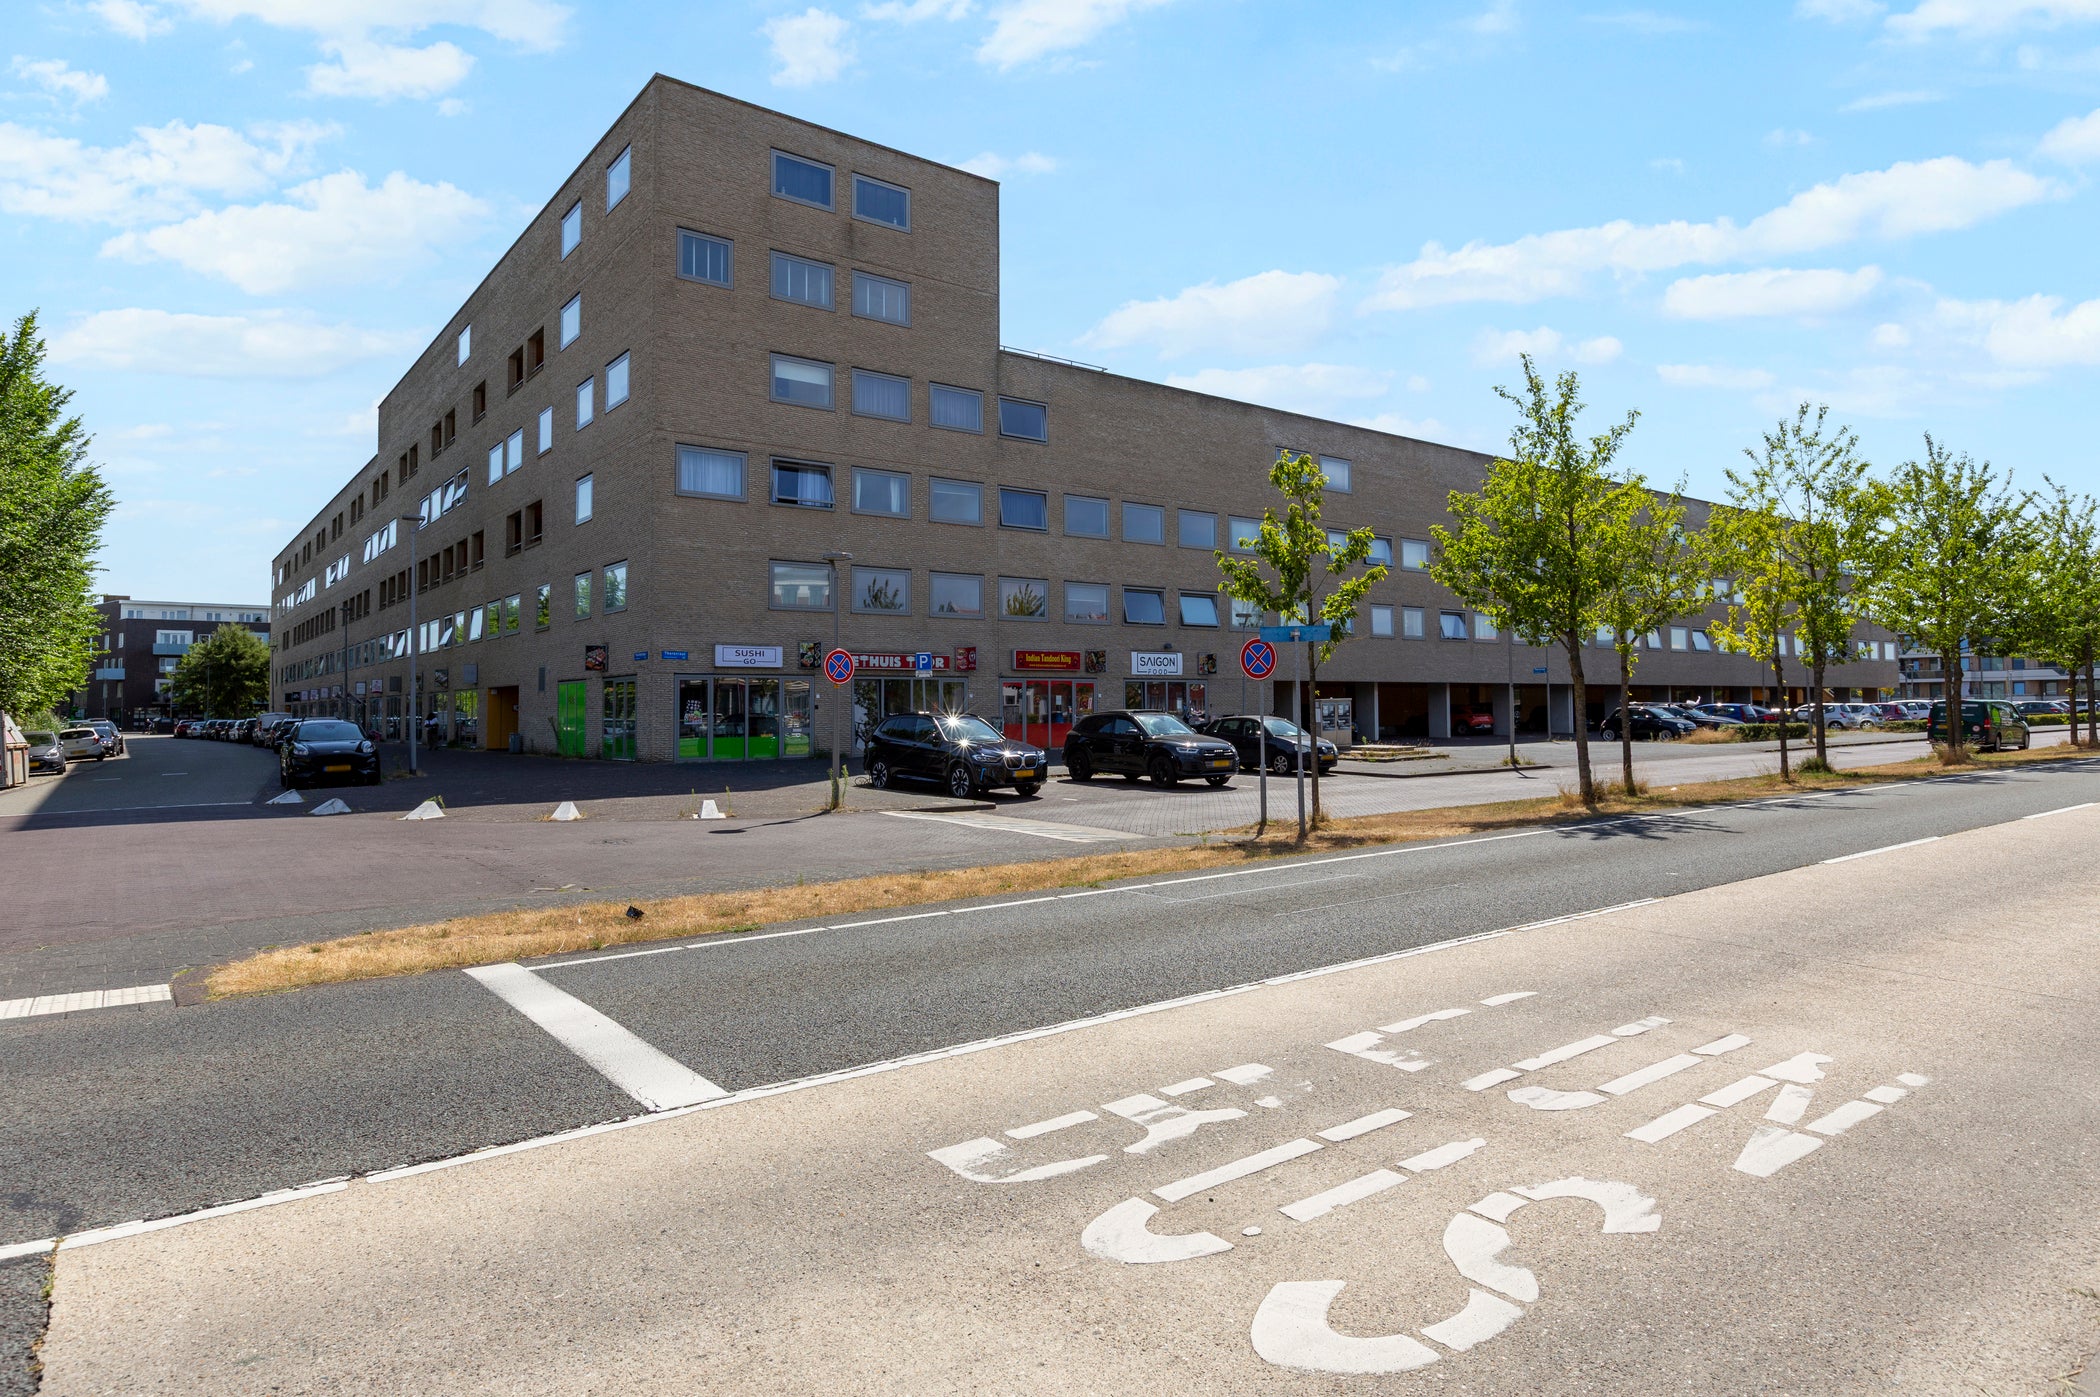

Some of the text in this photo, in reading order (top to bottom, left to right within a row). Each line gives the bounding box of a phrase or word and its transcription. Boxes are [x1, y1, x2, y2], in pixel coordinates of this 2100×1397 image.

[735, 649, 765, 657] SUSHI
[1025, 653, 1072, 664] Indian Tandoori King
[853, 654, 902, 668] ETHUIS
[919, 655, 929, 669] P
[1139, 656, 1176, 667] SAIGON
[1325, 991, 1930, 1178] LIJN
[927, 1063, 1662, 1375] BUS
